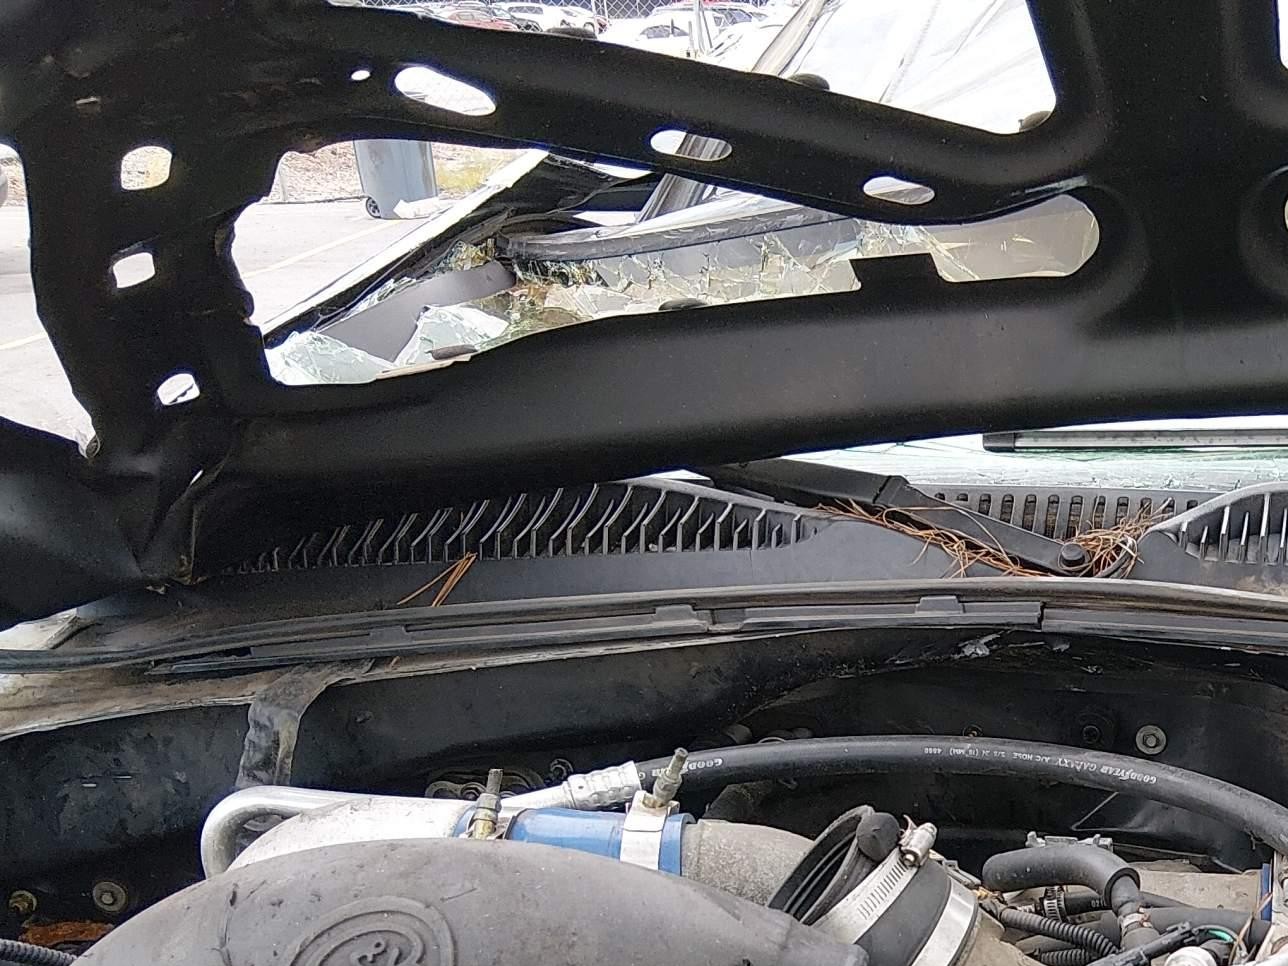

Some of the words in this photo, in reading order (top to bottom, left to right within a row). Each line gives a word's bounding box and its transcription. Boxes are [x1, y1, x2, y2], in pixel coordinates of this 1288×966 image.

[1013, 752, 1033, 760] HOSE
[1056, 758, 1097, 772] GALAXY
[1100, 765, 1157, 784] GOODYEAR
